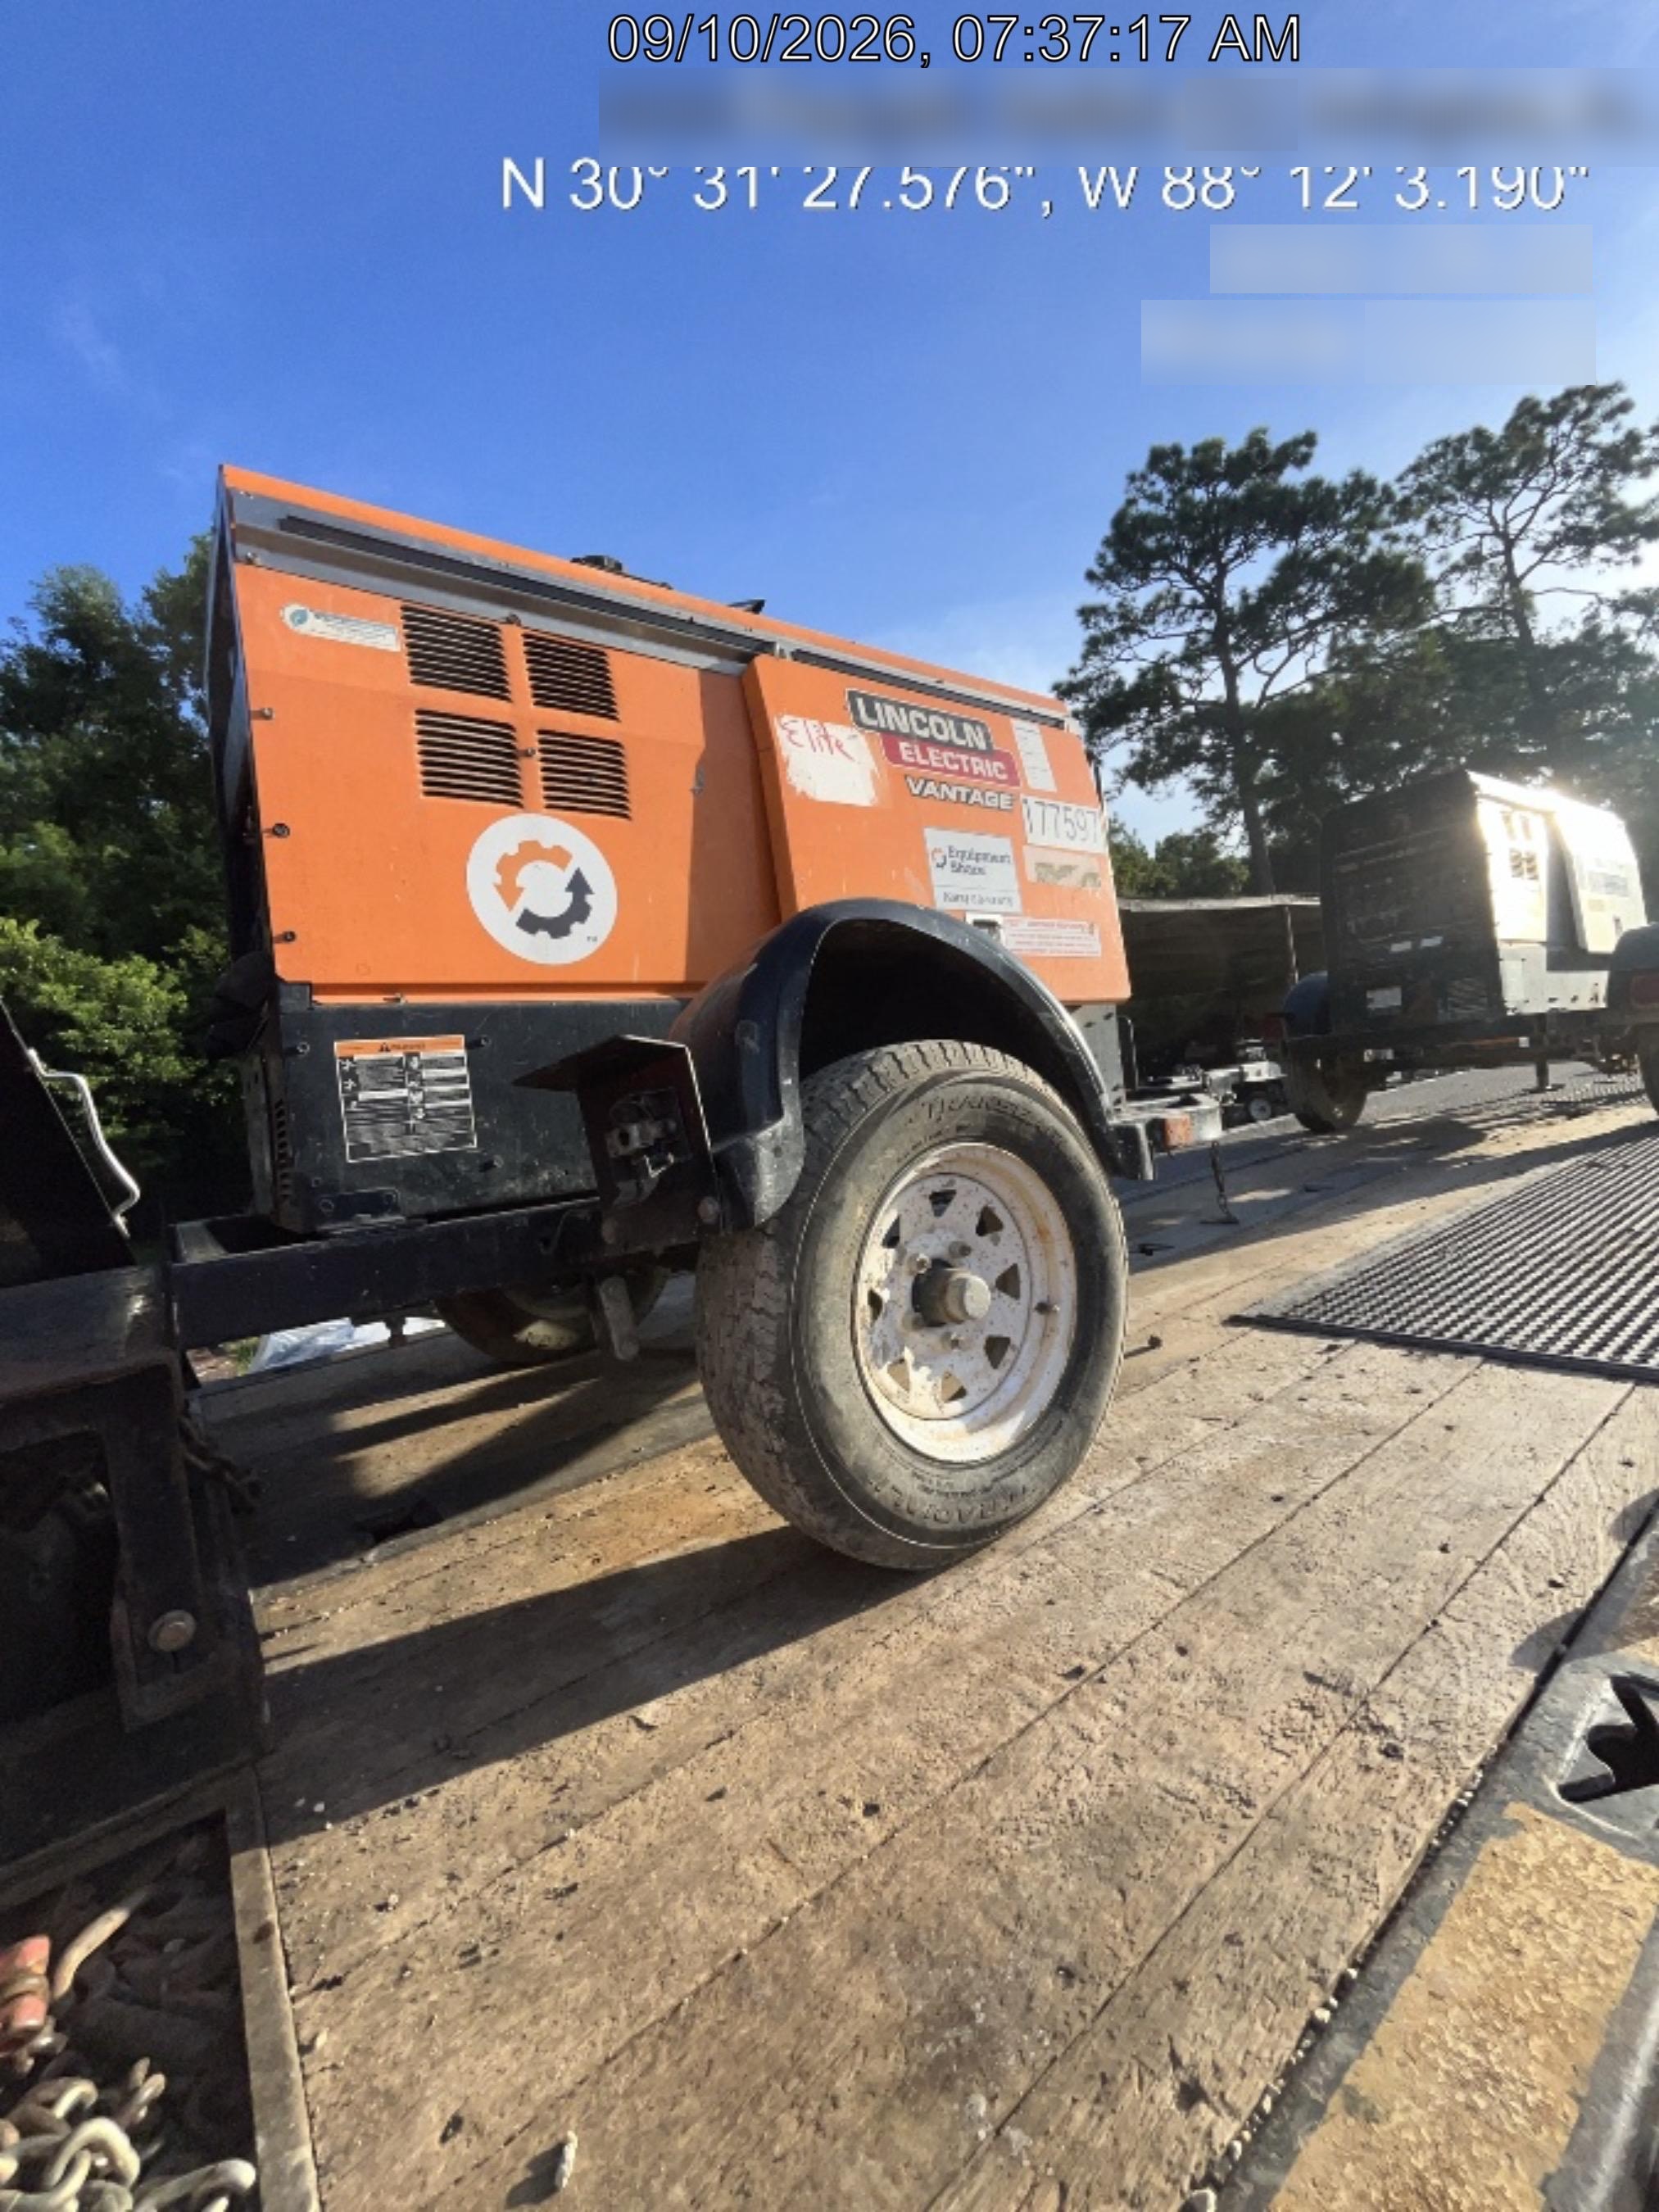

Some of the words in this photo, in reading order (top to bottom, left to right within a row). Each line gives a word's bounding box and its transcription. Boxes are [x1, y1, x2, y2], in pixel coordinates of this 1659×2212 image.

[780, 719, 854, 762] Elite
[857, 698, 986, 750] LINCOLN
[899, 741, 1008, 780] ELECTRIC
[904, 774, 1014, 812] VANTAGE
